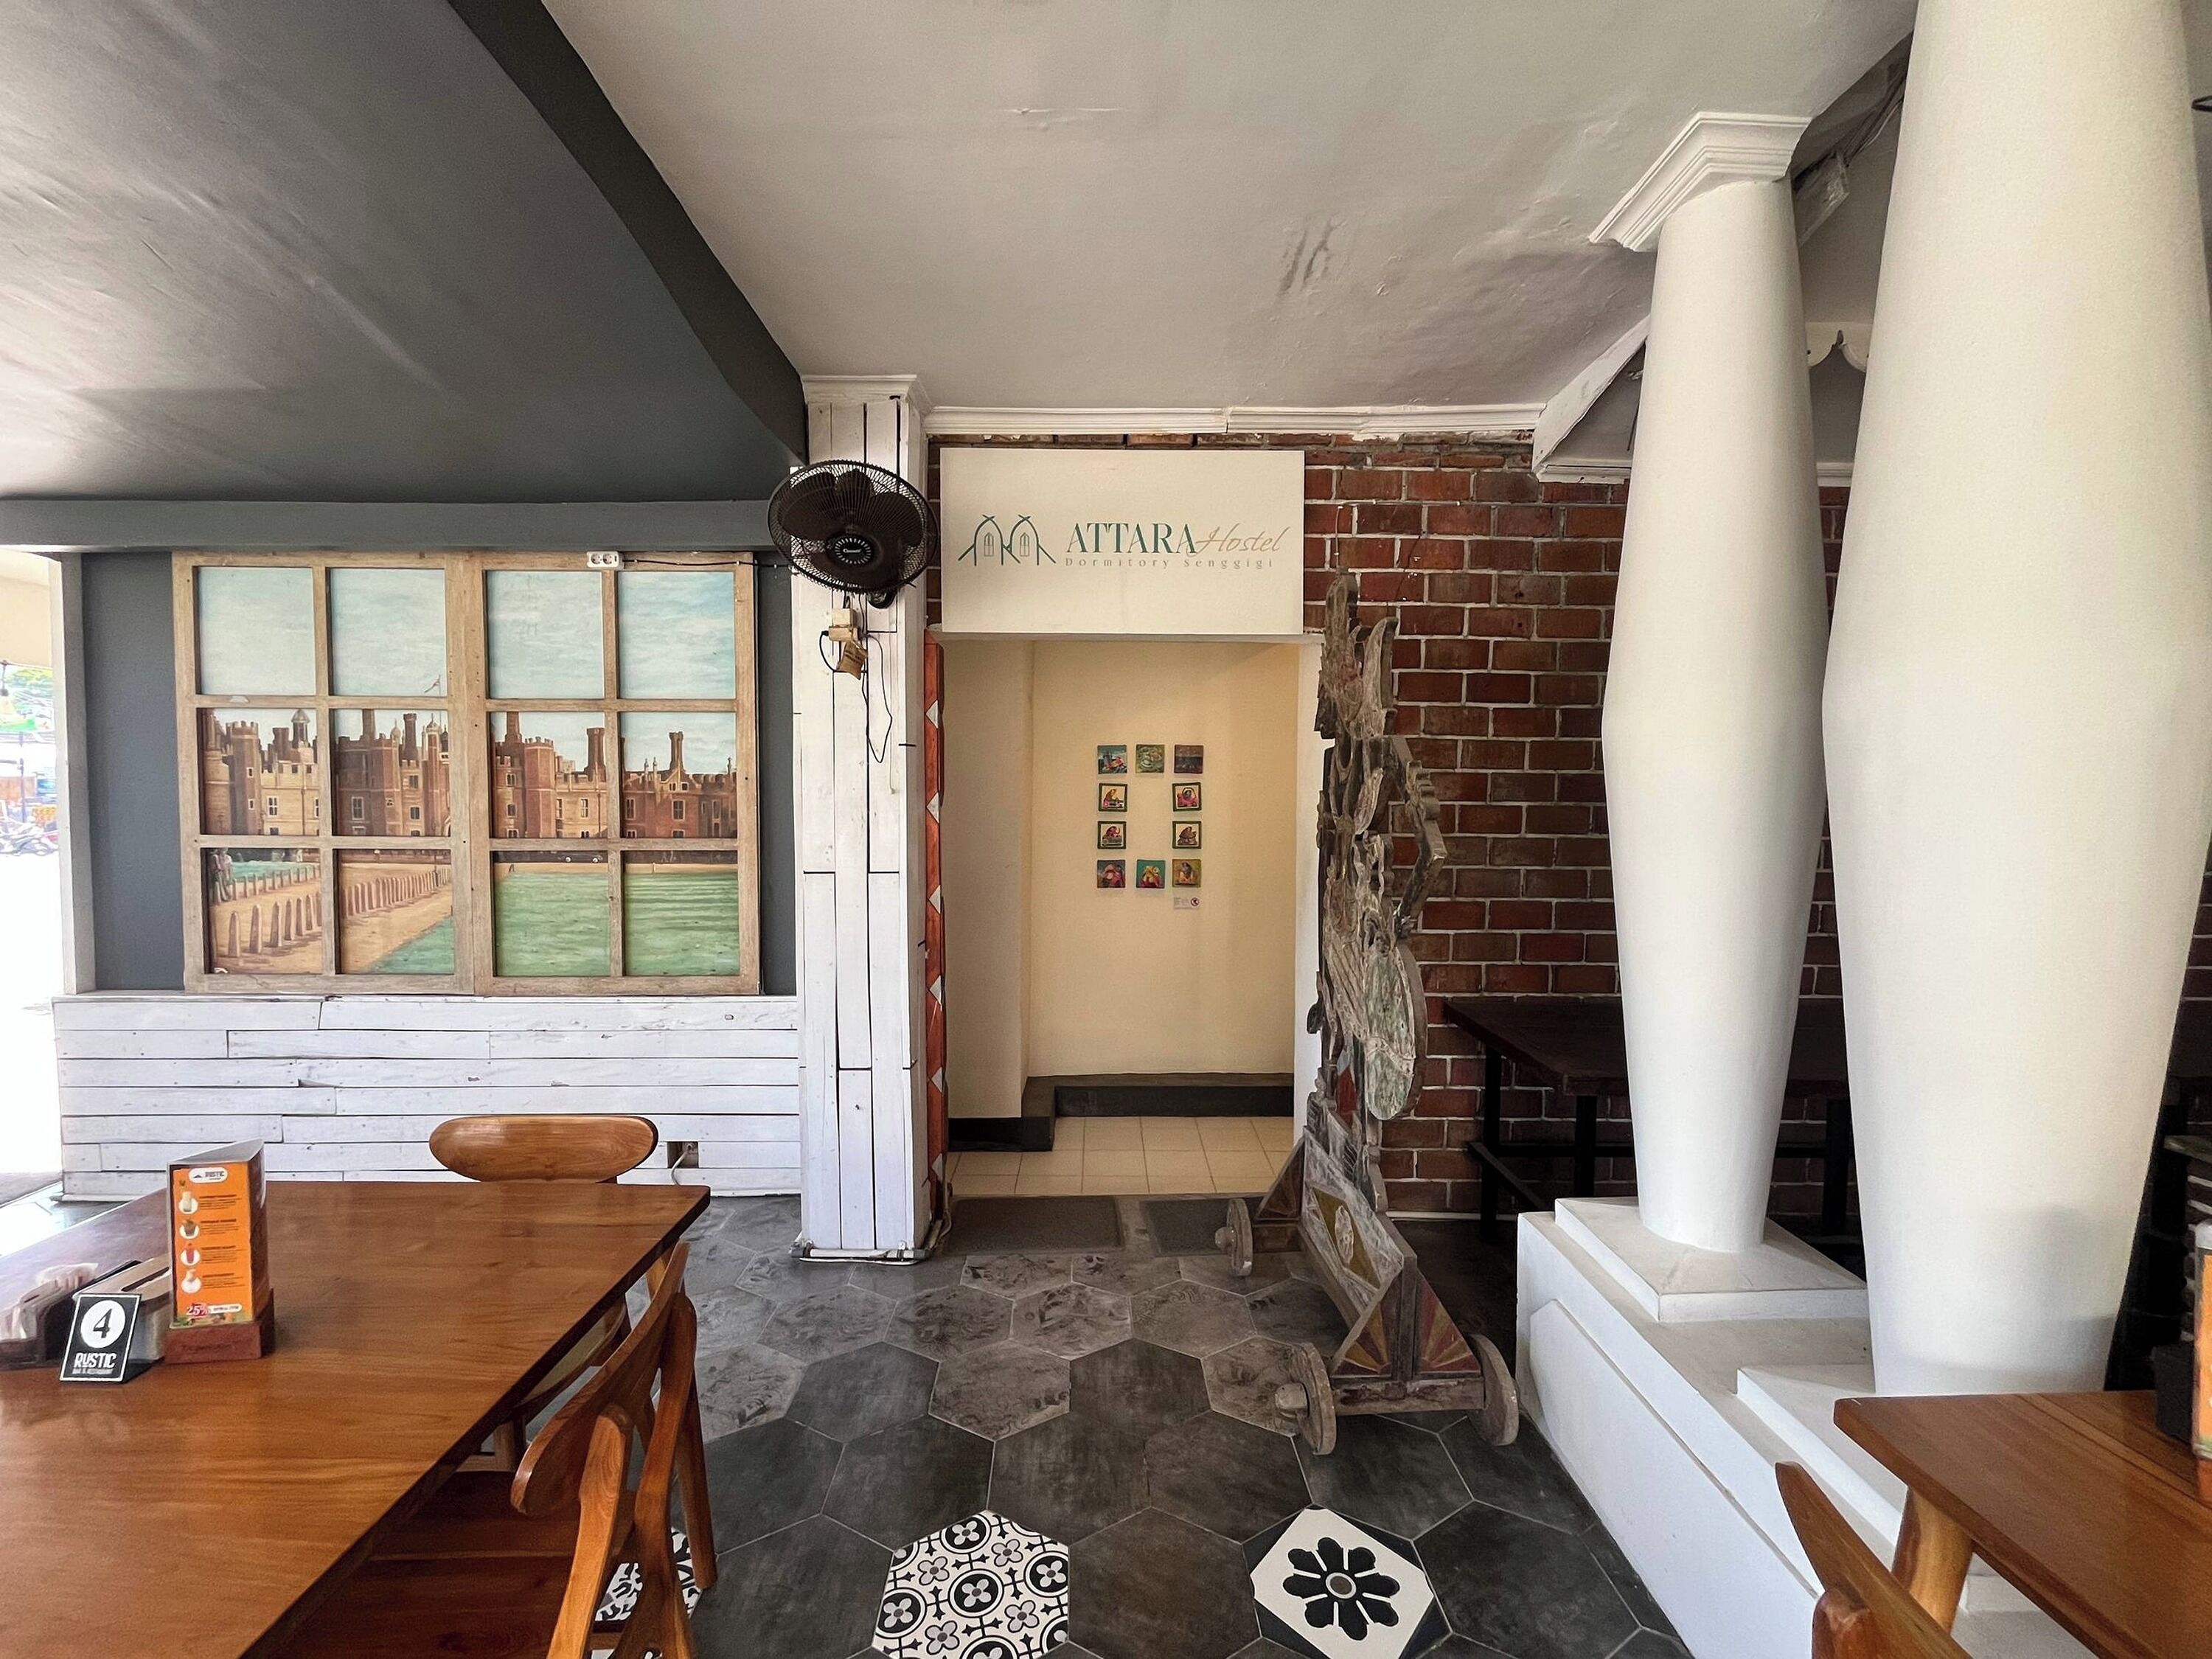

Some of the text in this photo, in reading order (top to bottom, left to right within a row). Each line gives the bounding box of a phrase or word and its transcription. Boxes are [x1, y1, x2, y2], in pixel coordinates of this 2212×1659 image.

[1066, 522, 1290, 557] ATTARA Hostel
[1065, 557, 1273, 569] Dormitory Senggigi
[93, 1308, 113, 1338] 4
[73, 1352, 116, 1368] RUSTIC
